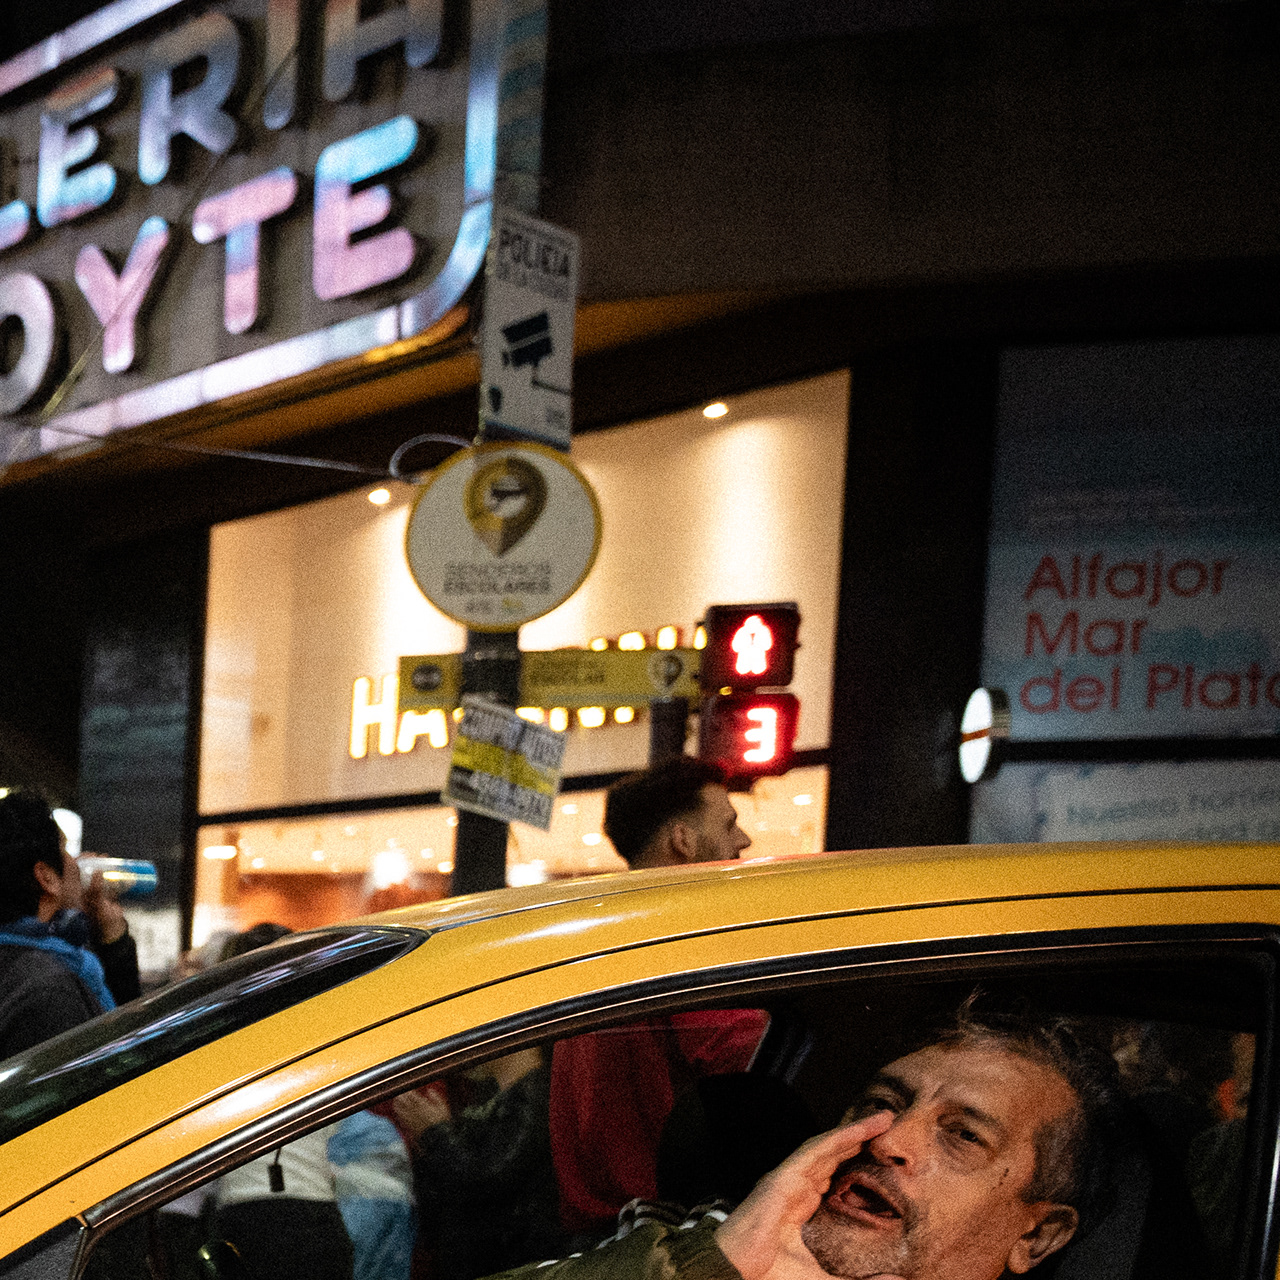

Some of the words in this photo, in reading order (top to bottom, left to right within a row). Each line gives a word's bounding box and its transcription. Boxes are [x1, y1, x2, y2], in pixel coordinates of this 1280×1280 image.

[1025, 551, 1233, 607] Alfajor
[1024, 610, 1149, 657] Mar
[1019, 667, 1121, 714] del
[744, 706, 777, 763] 3
